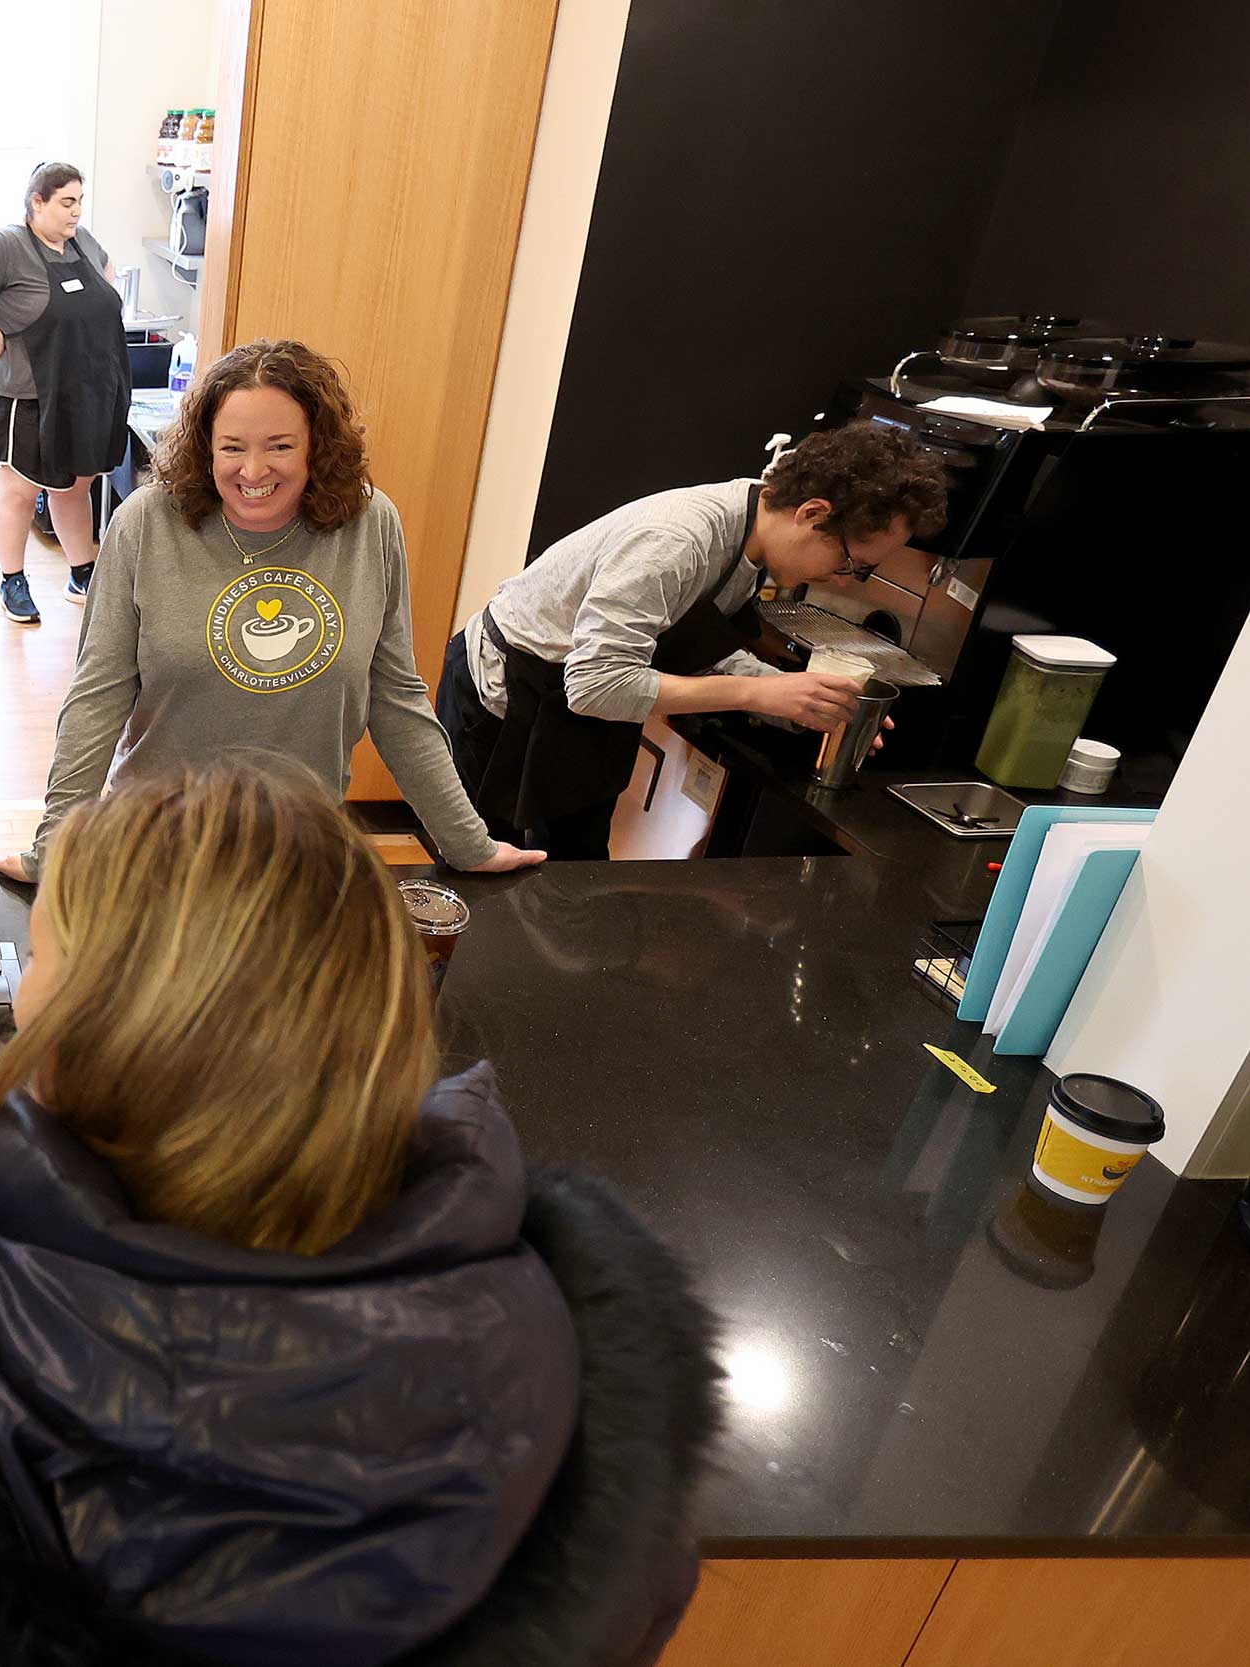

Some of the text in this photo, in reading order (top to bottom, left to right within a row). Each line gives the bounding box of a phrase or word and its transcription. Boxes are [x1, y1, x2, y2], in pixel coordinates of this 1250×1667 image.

[214, 572, 338, 641] KINDNESS CAFE & PLAY
[220, 643, 335, 688] CHARLOTTESVILLE, VA
